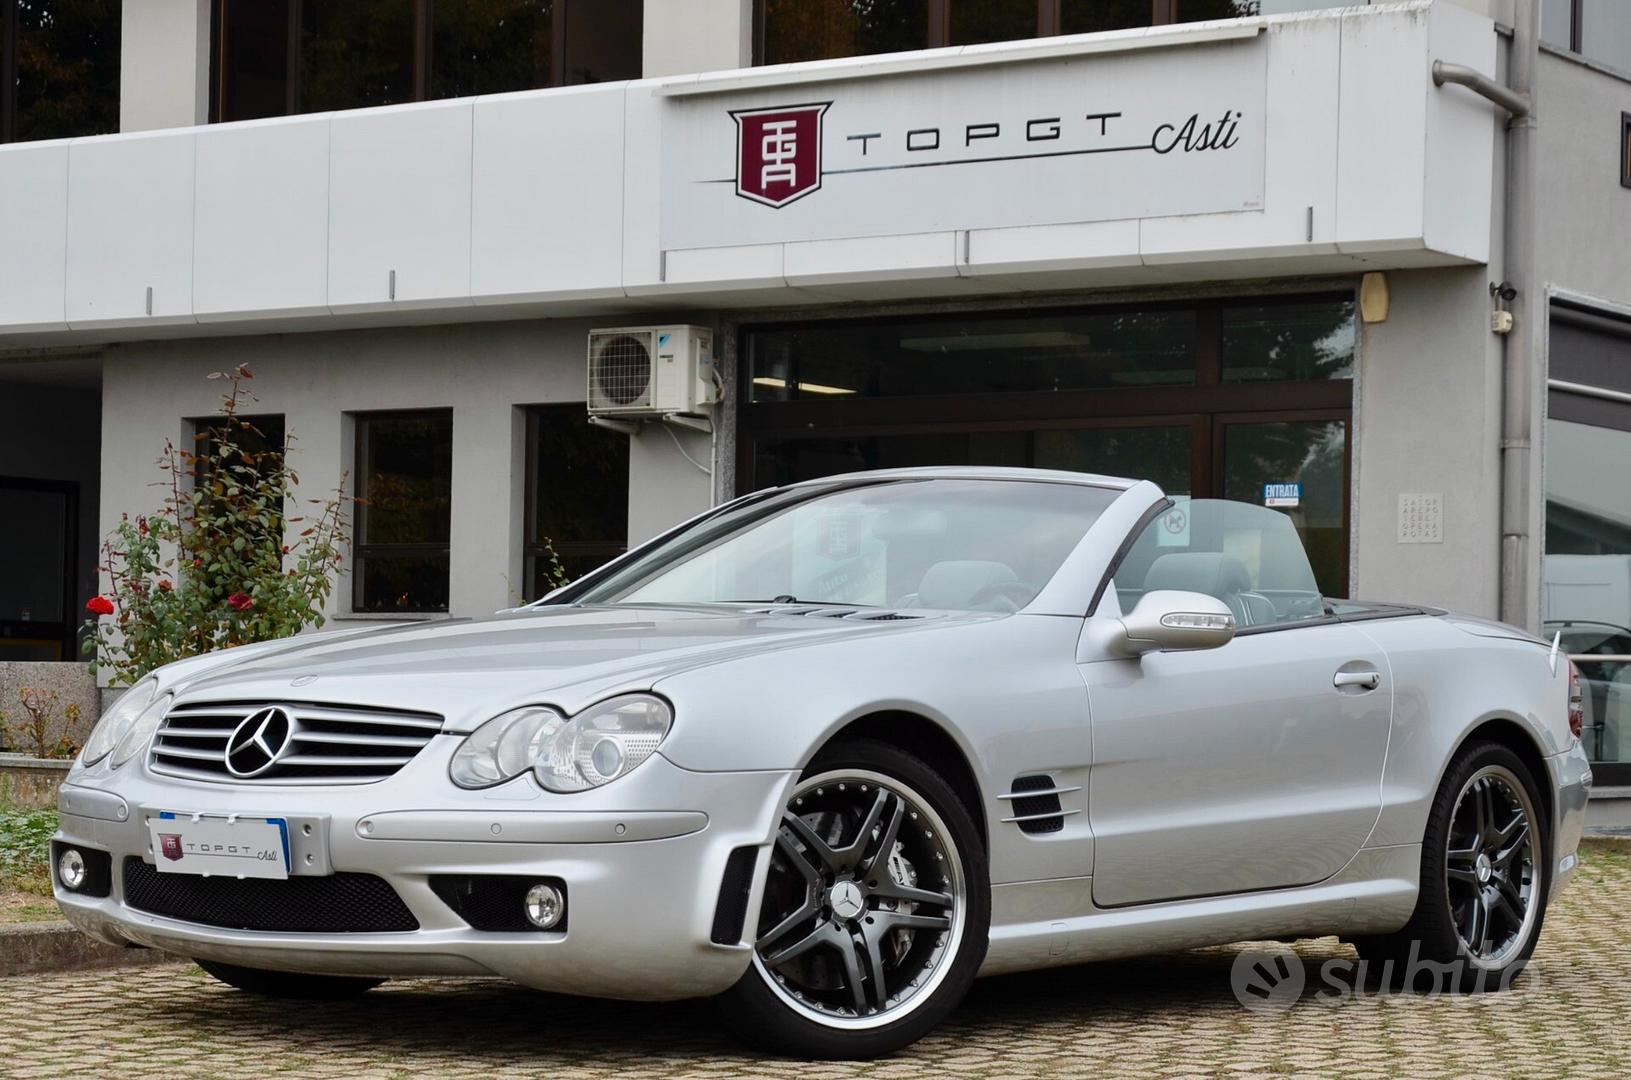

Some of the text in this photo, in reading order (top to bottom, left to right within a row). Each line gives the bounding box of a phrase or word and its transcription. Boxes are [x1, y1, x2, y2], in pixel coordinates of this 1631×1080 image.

[846, 109, 1243, 156] TOPGT Asti
[1265, 483, 1299, 498] ENTRATA
[186, 843, 278, 862] TOPGT Asti
